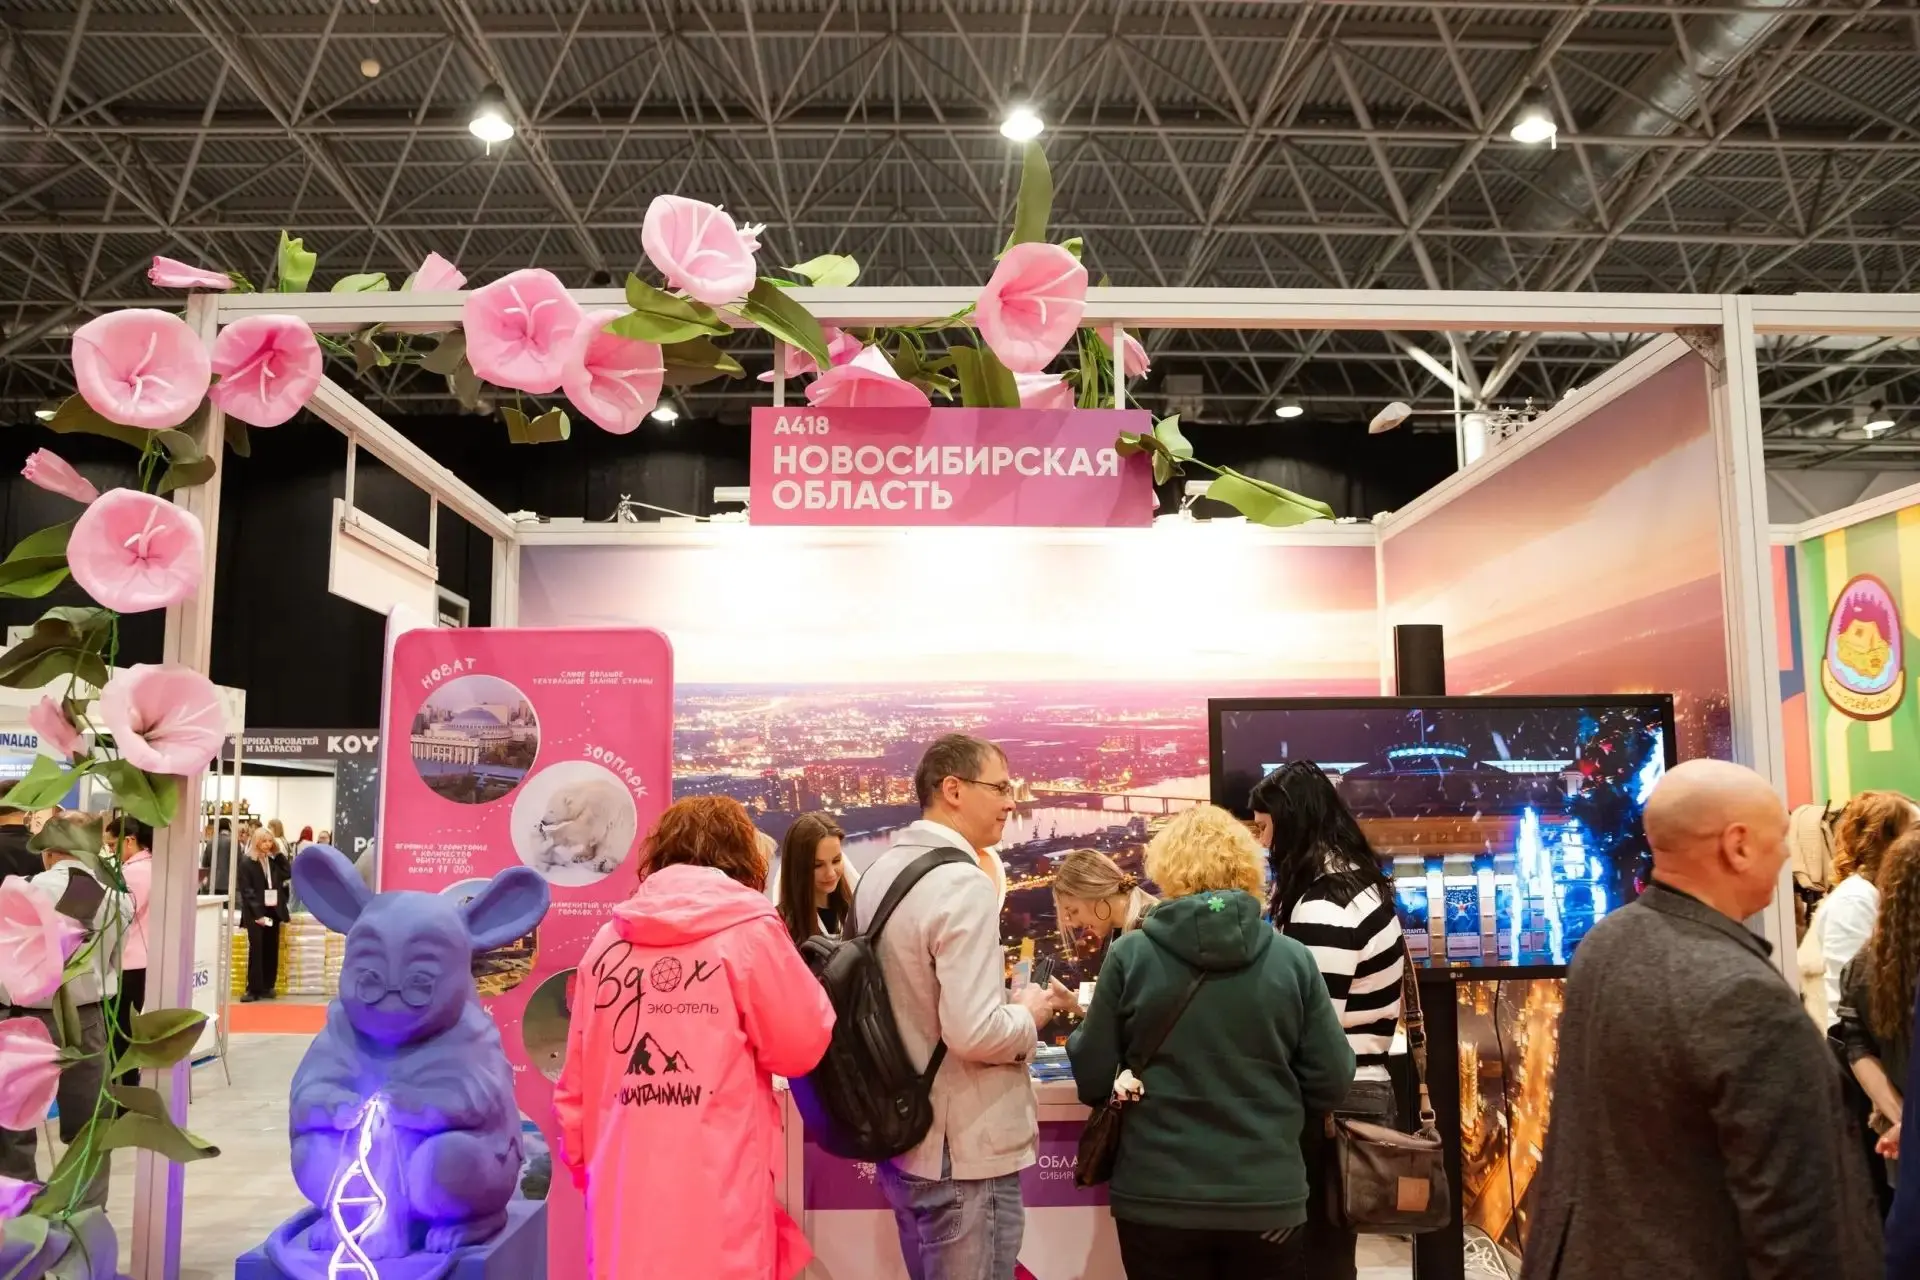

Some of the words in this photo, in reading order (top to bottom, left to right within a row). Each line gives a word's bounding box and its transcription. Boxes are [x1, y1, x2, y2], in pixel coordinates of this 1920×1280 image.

[773, 445, 1119, 476] НОВОСИБИРСКАЯ
[772, 480, 953, 510] ОБЛАСТЬ
[421, 658, 477, 689] НОВАТ
[229, 737, 271, 745] ФБРИКА
[582, 742, 648, 800] ЗООПАРК
[647, 1003, 719, 1015] эко-отель
